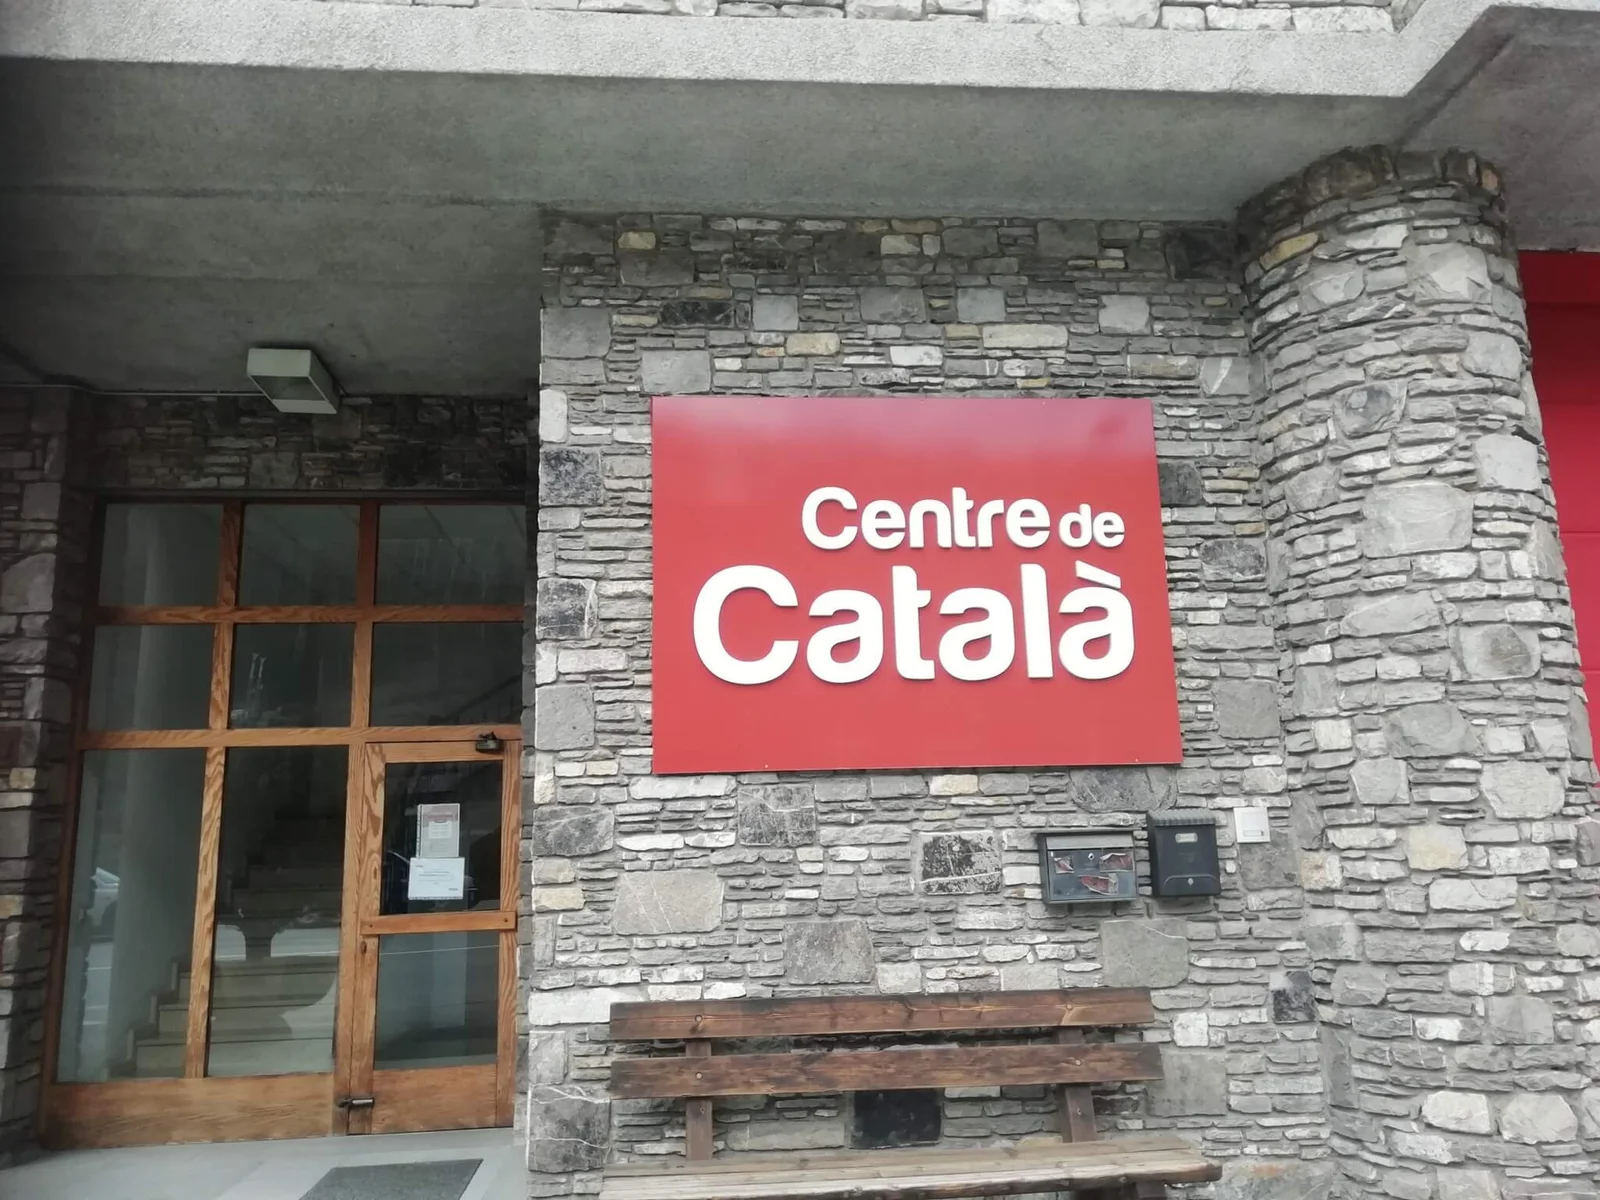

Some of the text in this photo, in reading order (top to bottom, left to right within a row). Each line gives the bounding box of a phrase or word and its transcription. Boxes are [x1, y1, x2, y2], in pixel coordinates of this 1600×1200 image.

[802, 486, 1125, 549] Centre de
[693, 560, 1135, 685] Català
